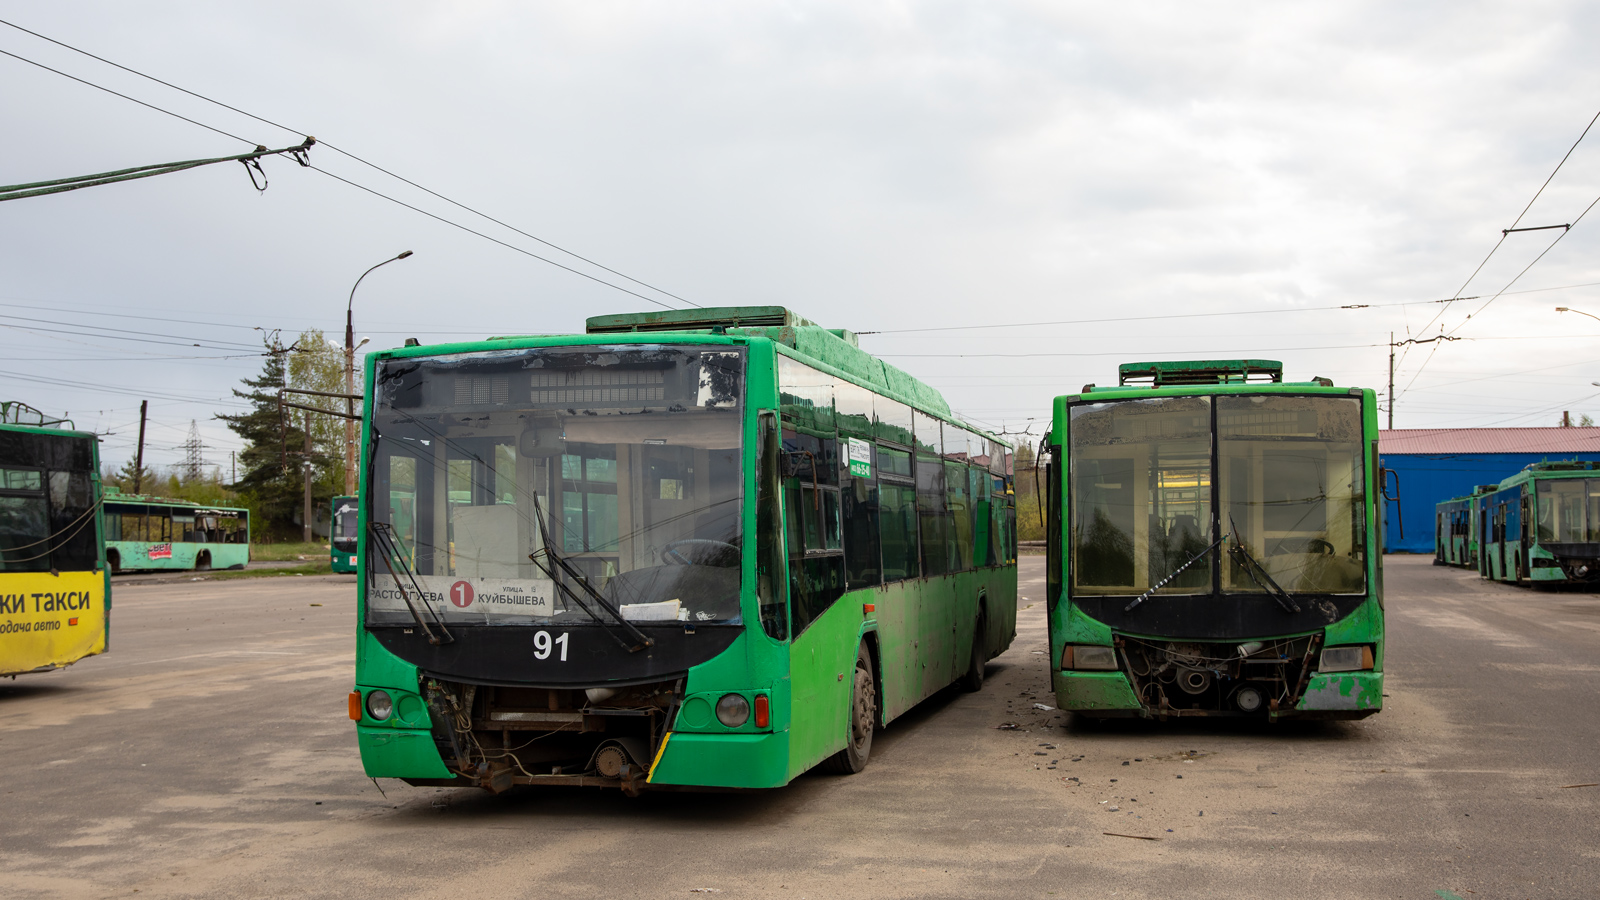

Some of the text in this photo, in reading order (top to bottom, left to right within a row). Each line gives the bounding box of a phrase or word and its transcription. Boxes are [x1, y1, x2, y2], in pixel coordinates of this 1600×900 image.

[31, 591, 90, 612] такси
[455, 583, 465, 606] 1
[33, 620, 61, 632] авто
[533, 630, 569, 662] 91
